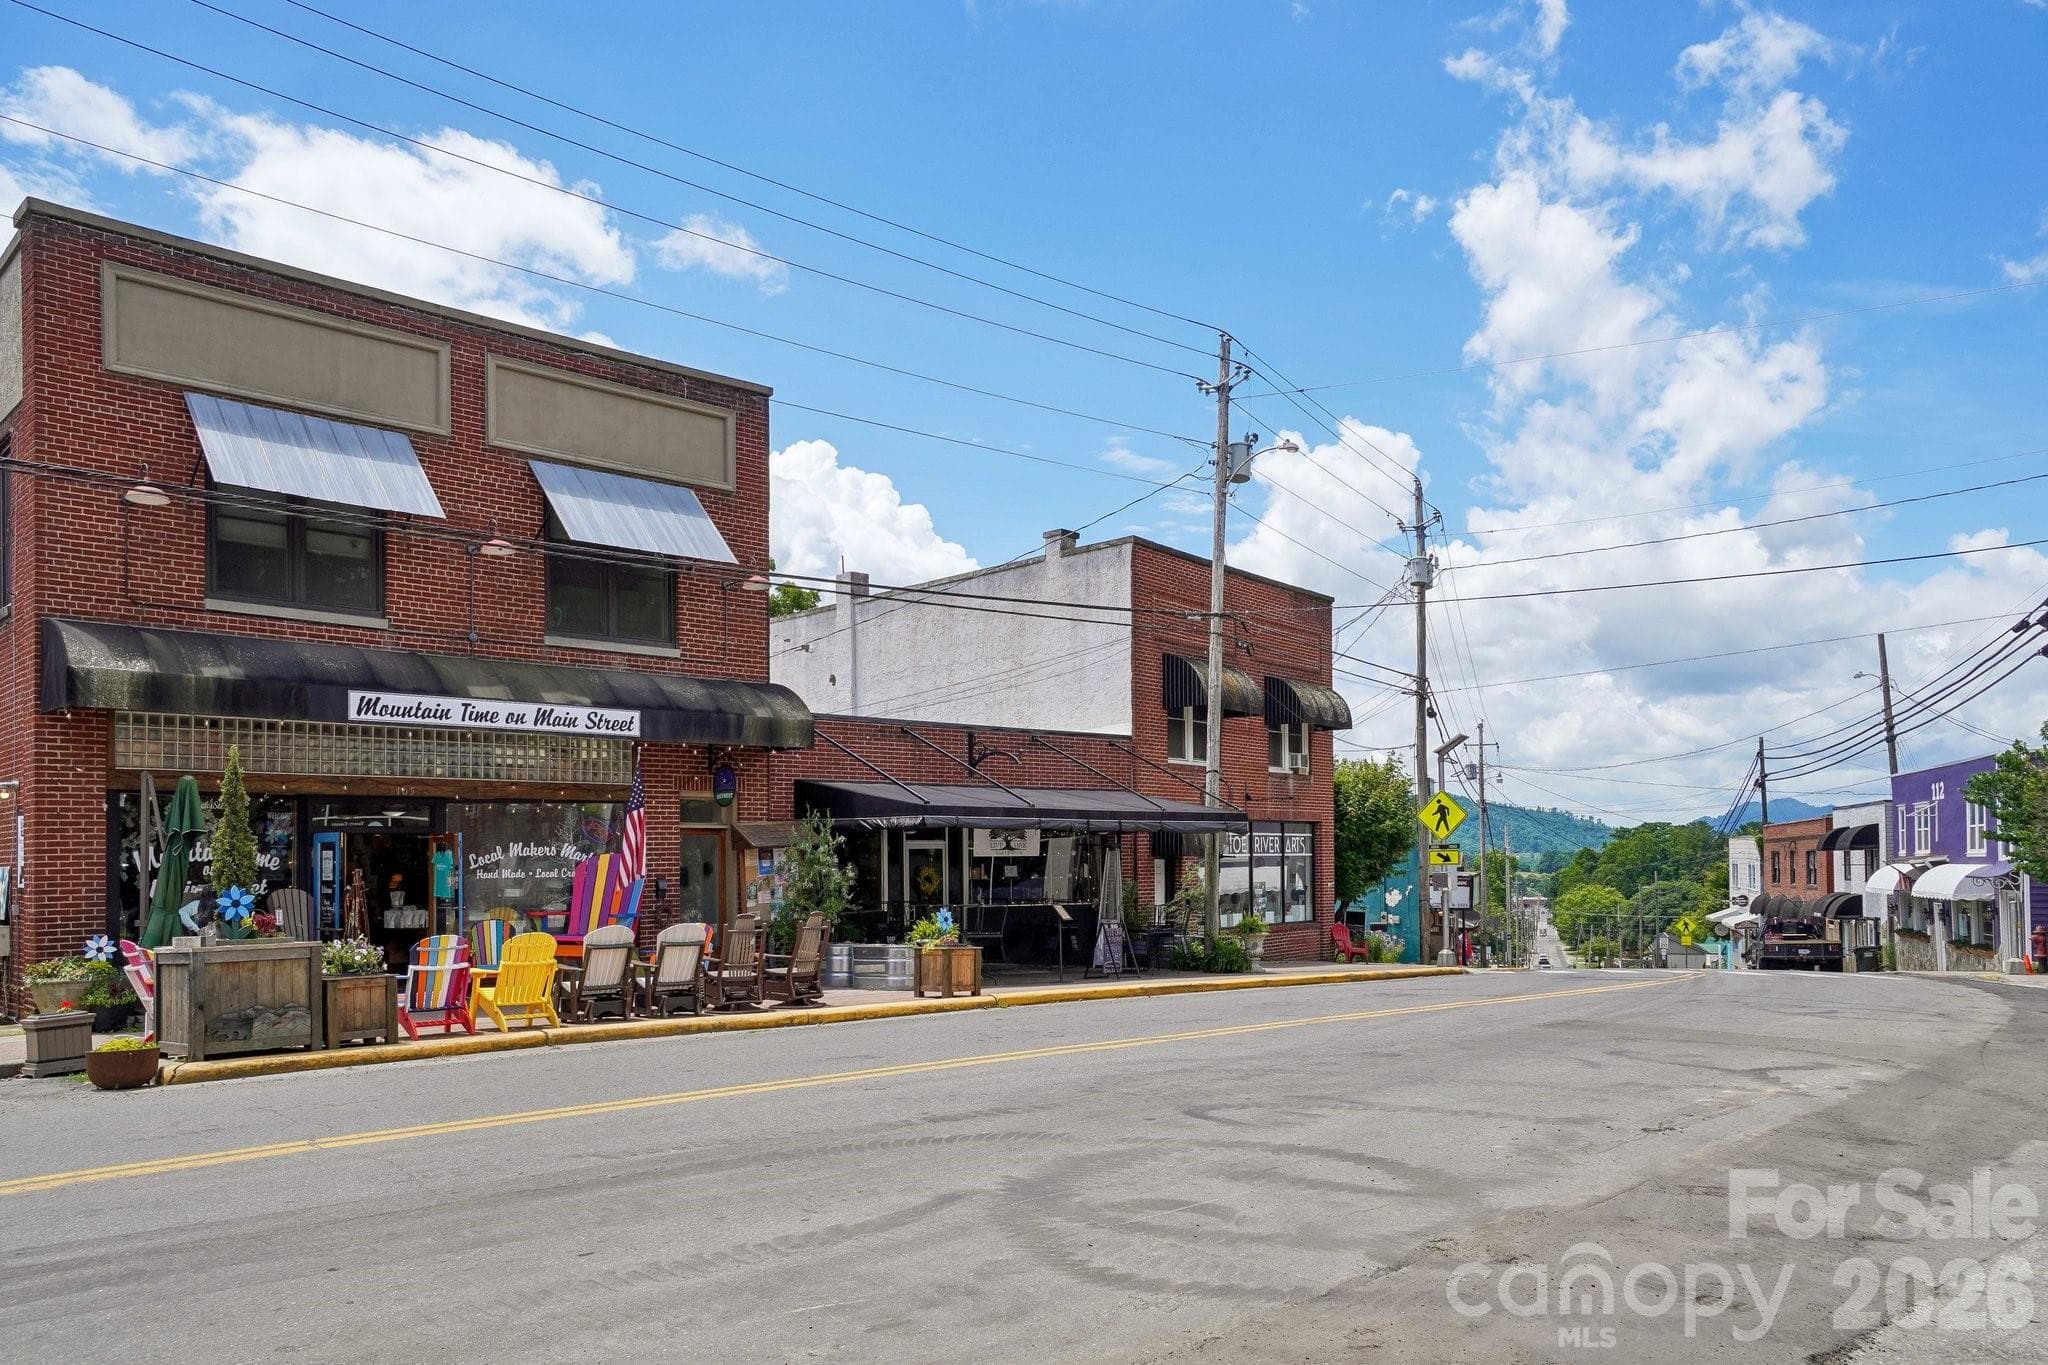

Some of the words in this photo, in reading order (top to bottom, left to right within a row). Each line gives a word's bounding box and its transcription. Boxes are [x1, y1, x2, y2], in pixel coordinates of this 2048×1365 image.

[355, 695, 452, 721] Mountain
[461, 702, 500, 723] Time
[505, 712, 527, 725] on
[533, 707, 579, 728] Main
[584, 711, 636, 732] Street
[1931, 781, 1945, 801] 112
[1254, 836, 1280, 853] RIVER
[1285, 836, 1306, 854] ARTS
[468, 846, 505, 870] Local
[509, 842, 557, 857] Makers
[476, 869, 499, 880] Hand
[501, 869, 526, 880] Made
[534, 868, 558, 878] Local
